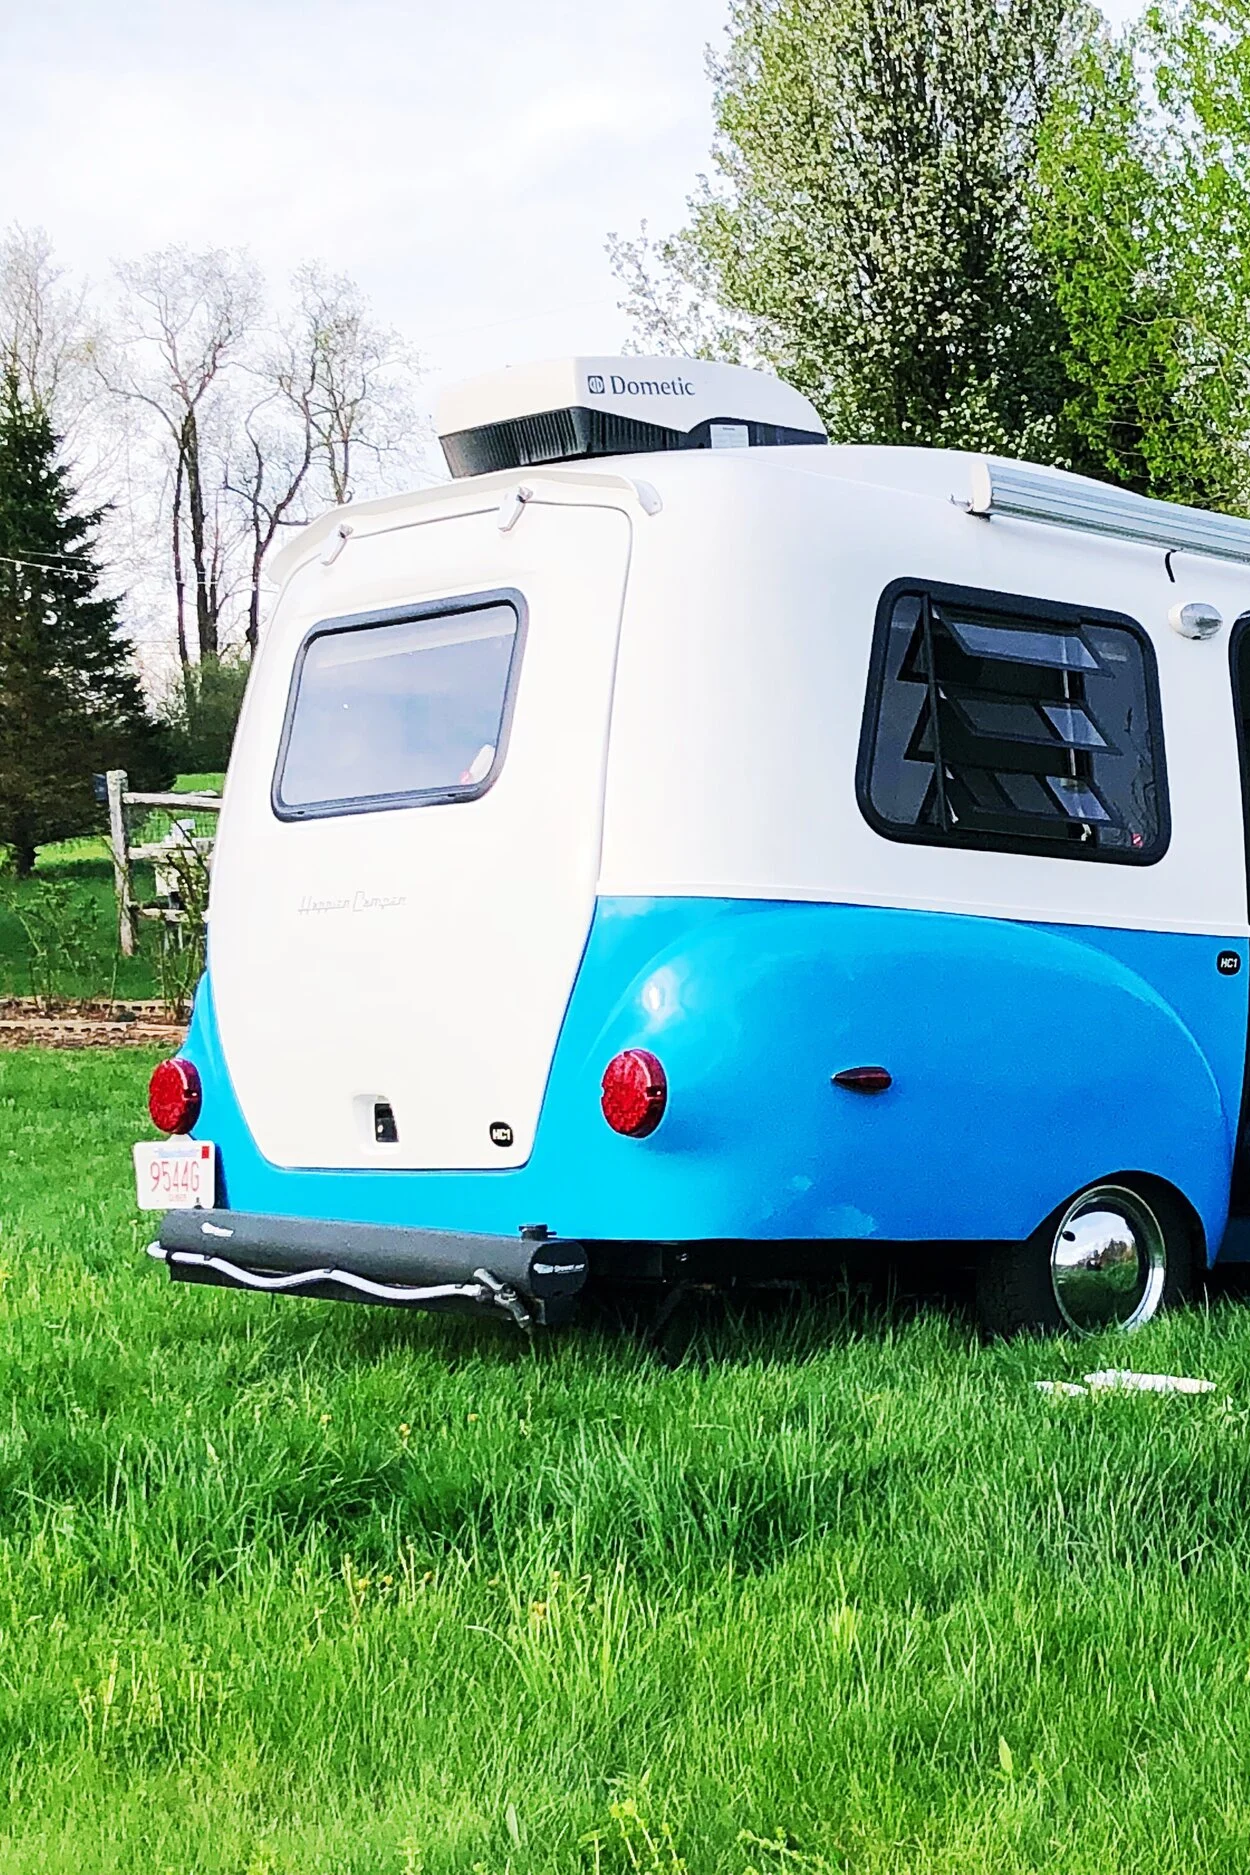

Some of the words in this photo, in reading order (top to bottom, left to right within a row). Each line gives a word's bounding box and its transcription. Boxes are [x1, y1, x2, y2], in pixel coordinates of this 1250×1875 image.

[610, 375, 695, 396] Dometic
[1220, 957, 1239, 968] HC1
[492, 1128, 511, 1141] HC1
